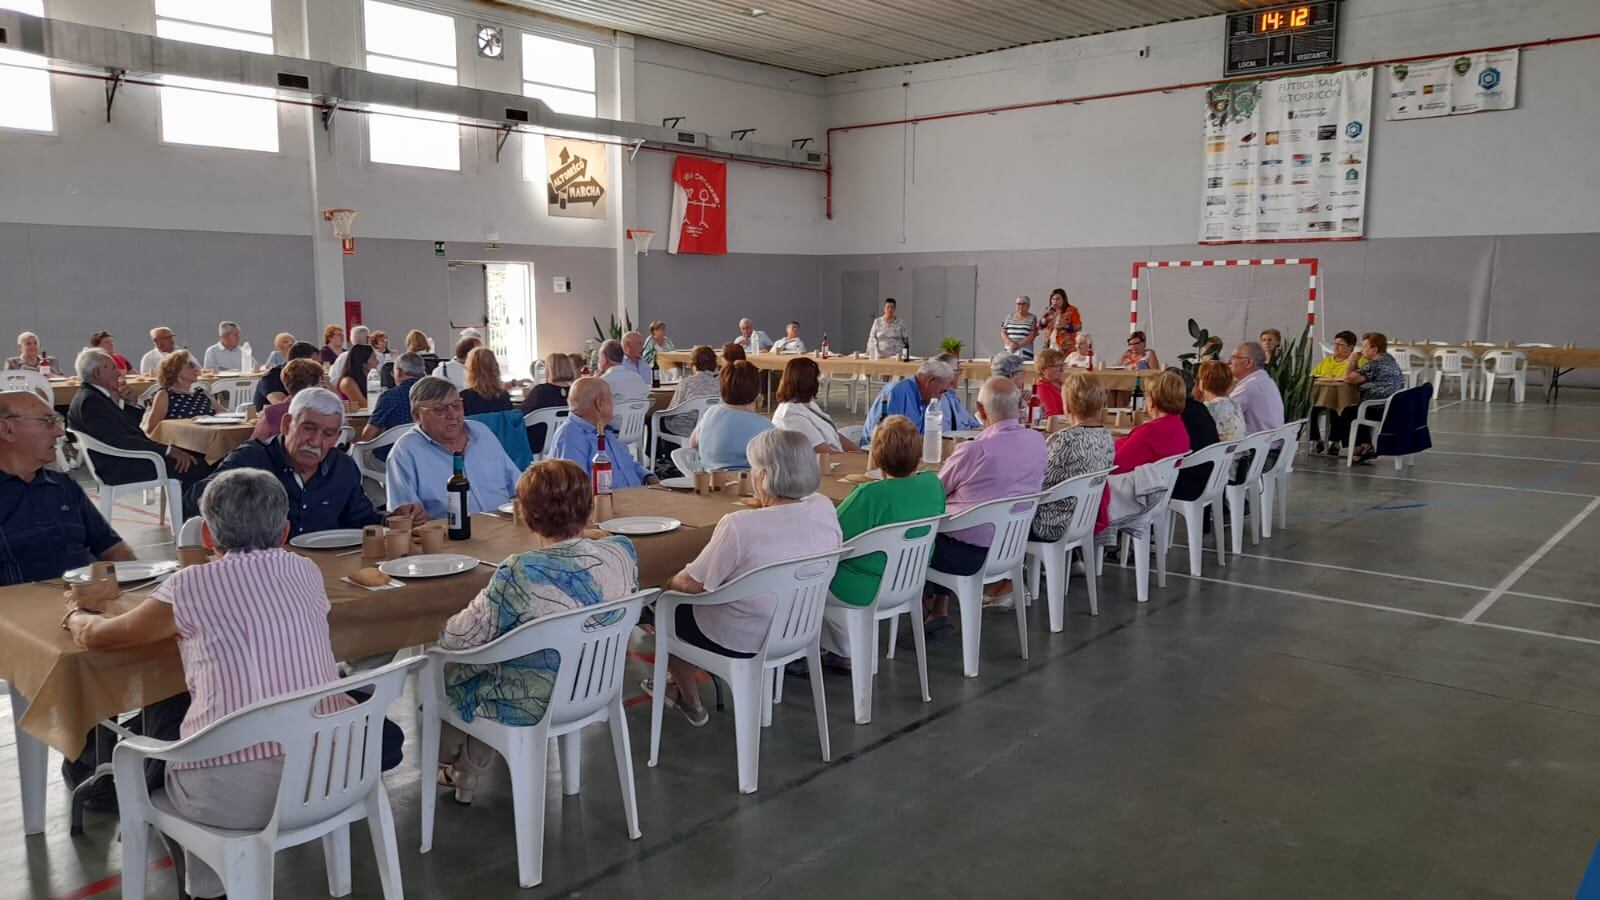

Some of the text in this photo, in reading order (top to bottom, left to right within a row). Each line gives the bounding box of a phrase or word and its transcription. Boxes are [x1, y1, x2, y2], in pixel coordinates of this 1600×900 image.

[1261, 7, 1309, 31] 14:12
[1238, 60, 1257, 69] LOCAL
[1317, 78, 1341, 88] SALA
[569, 185, 601, 199] MARCHA
